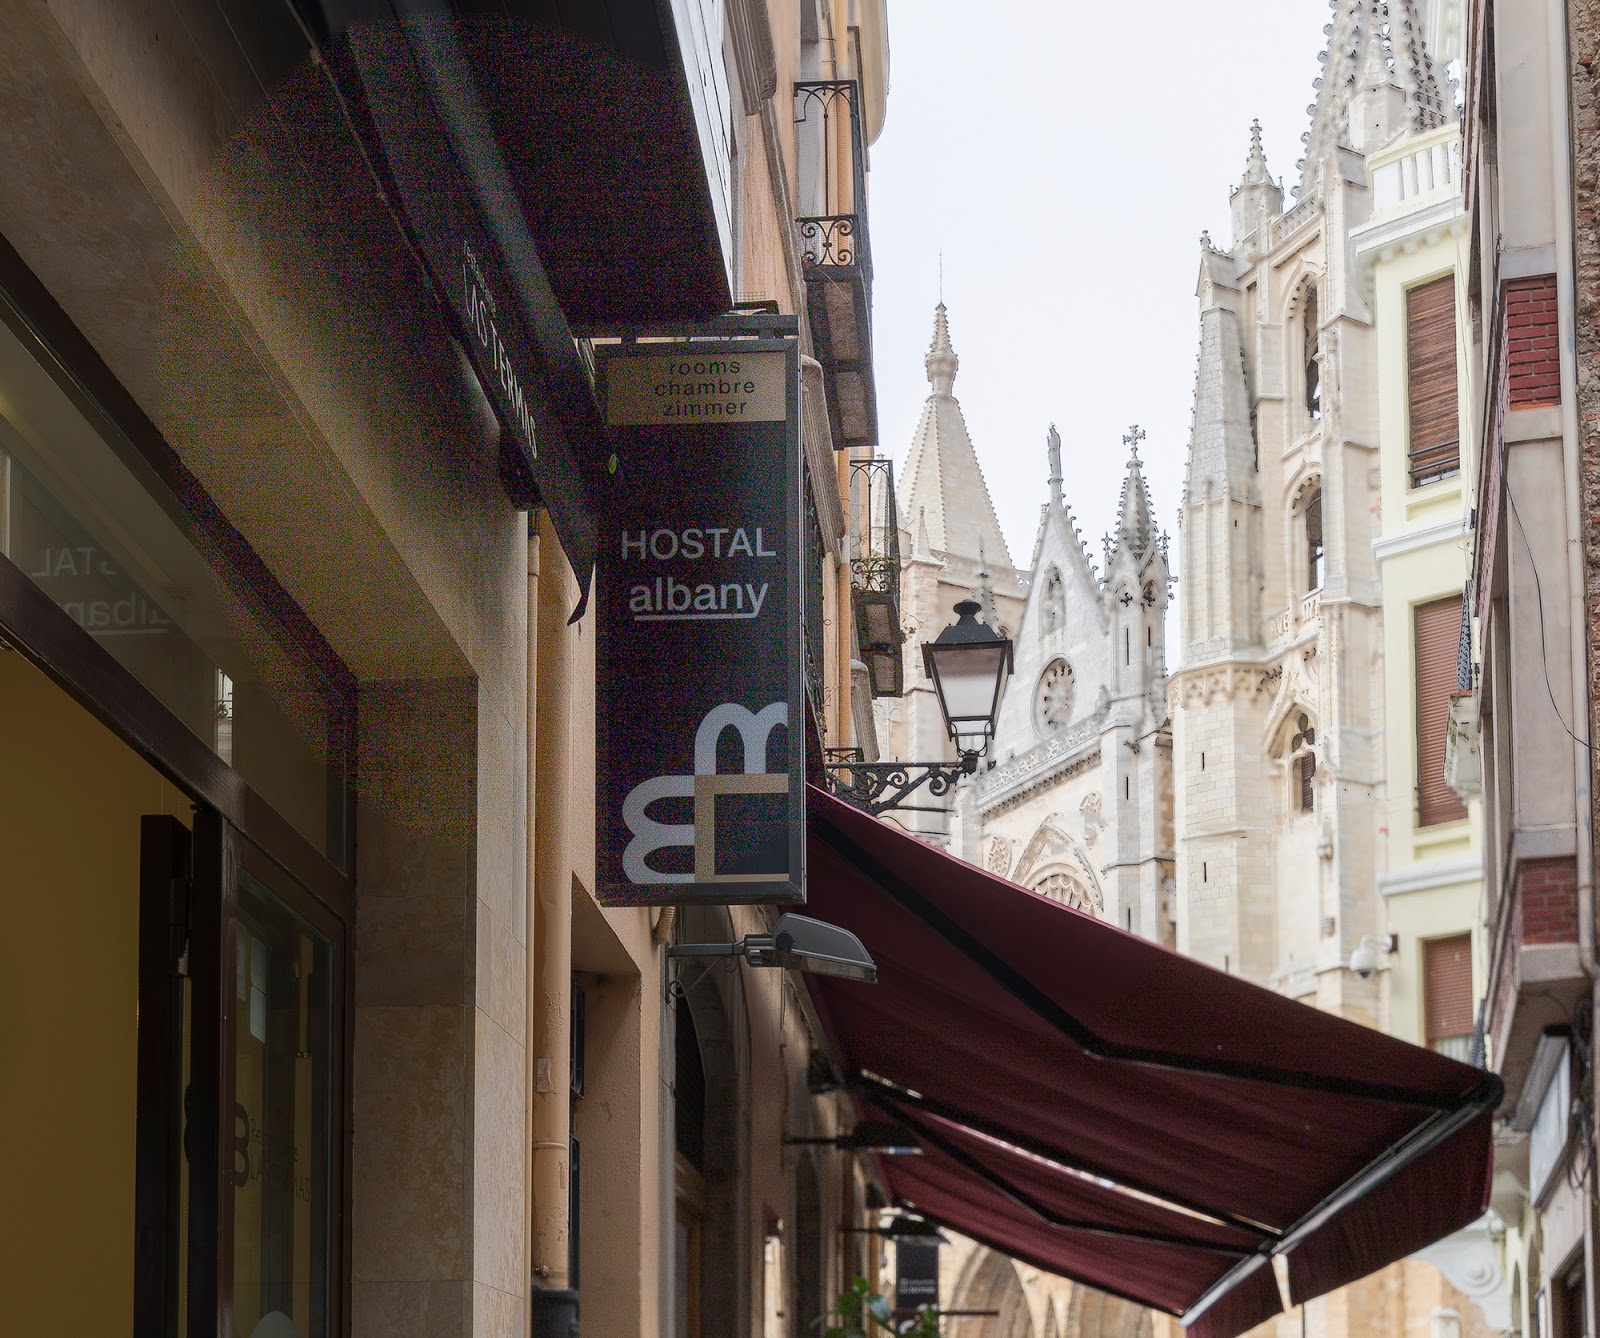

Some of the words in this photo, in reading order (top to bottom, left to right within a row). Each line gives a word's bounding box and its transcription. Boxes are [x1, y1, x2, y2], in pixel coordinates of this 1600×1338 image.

[462, 263, 488, 347] LAS
[490, 320, 538, 460] TERMAS
[669, 359, 742, 376] rooms
[655, 378, 756, 397] chambre
[663, 399, 748, 417] zimmer
[621, 527, 778, 561] HOSTAL
[628, 576, 770, 620] albany
